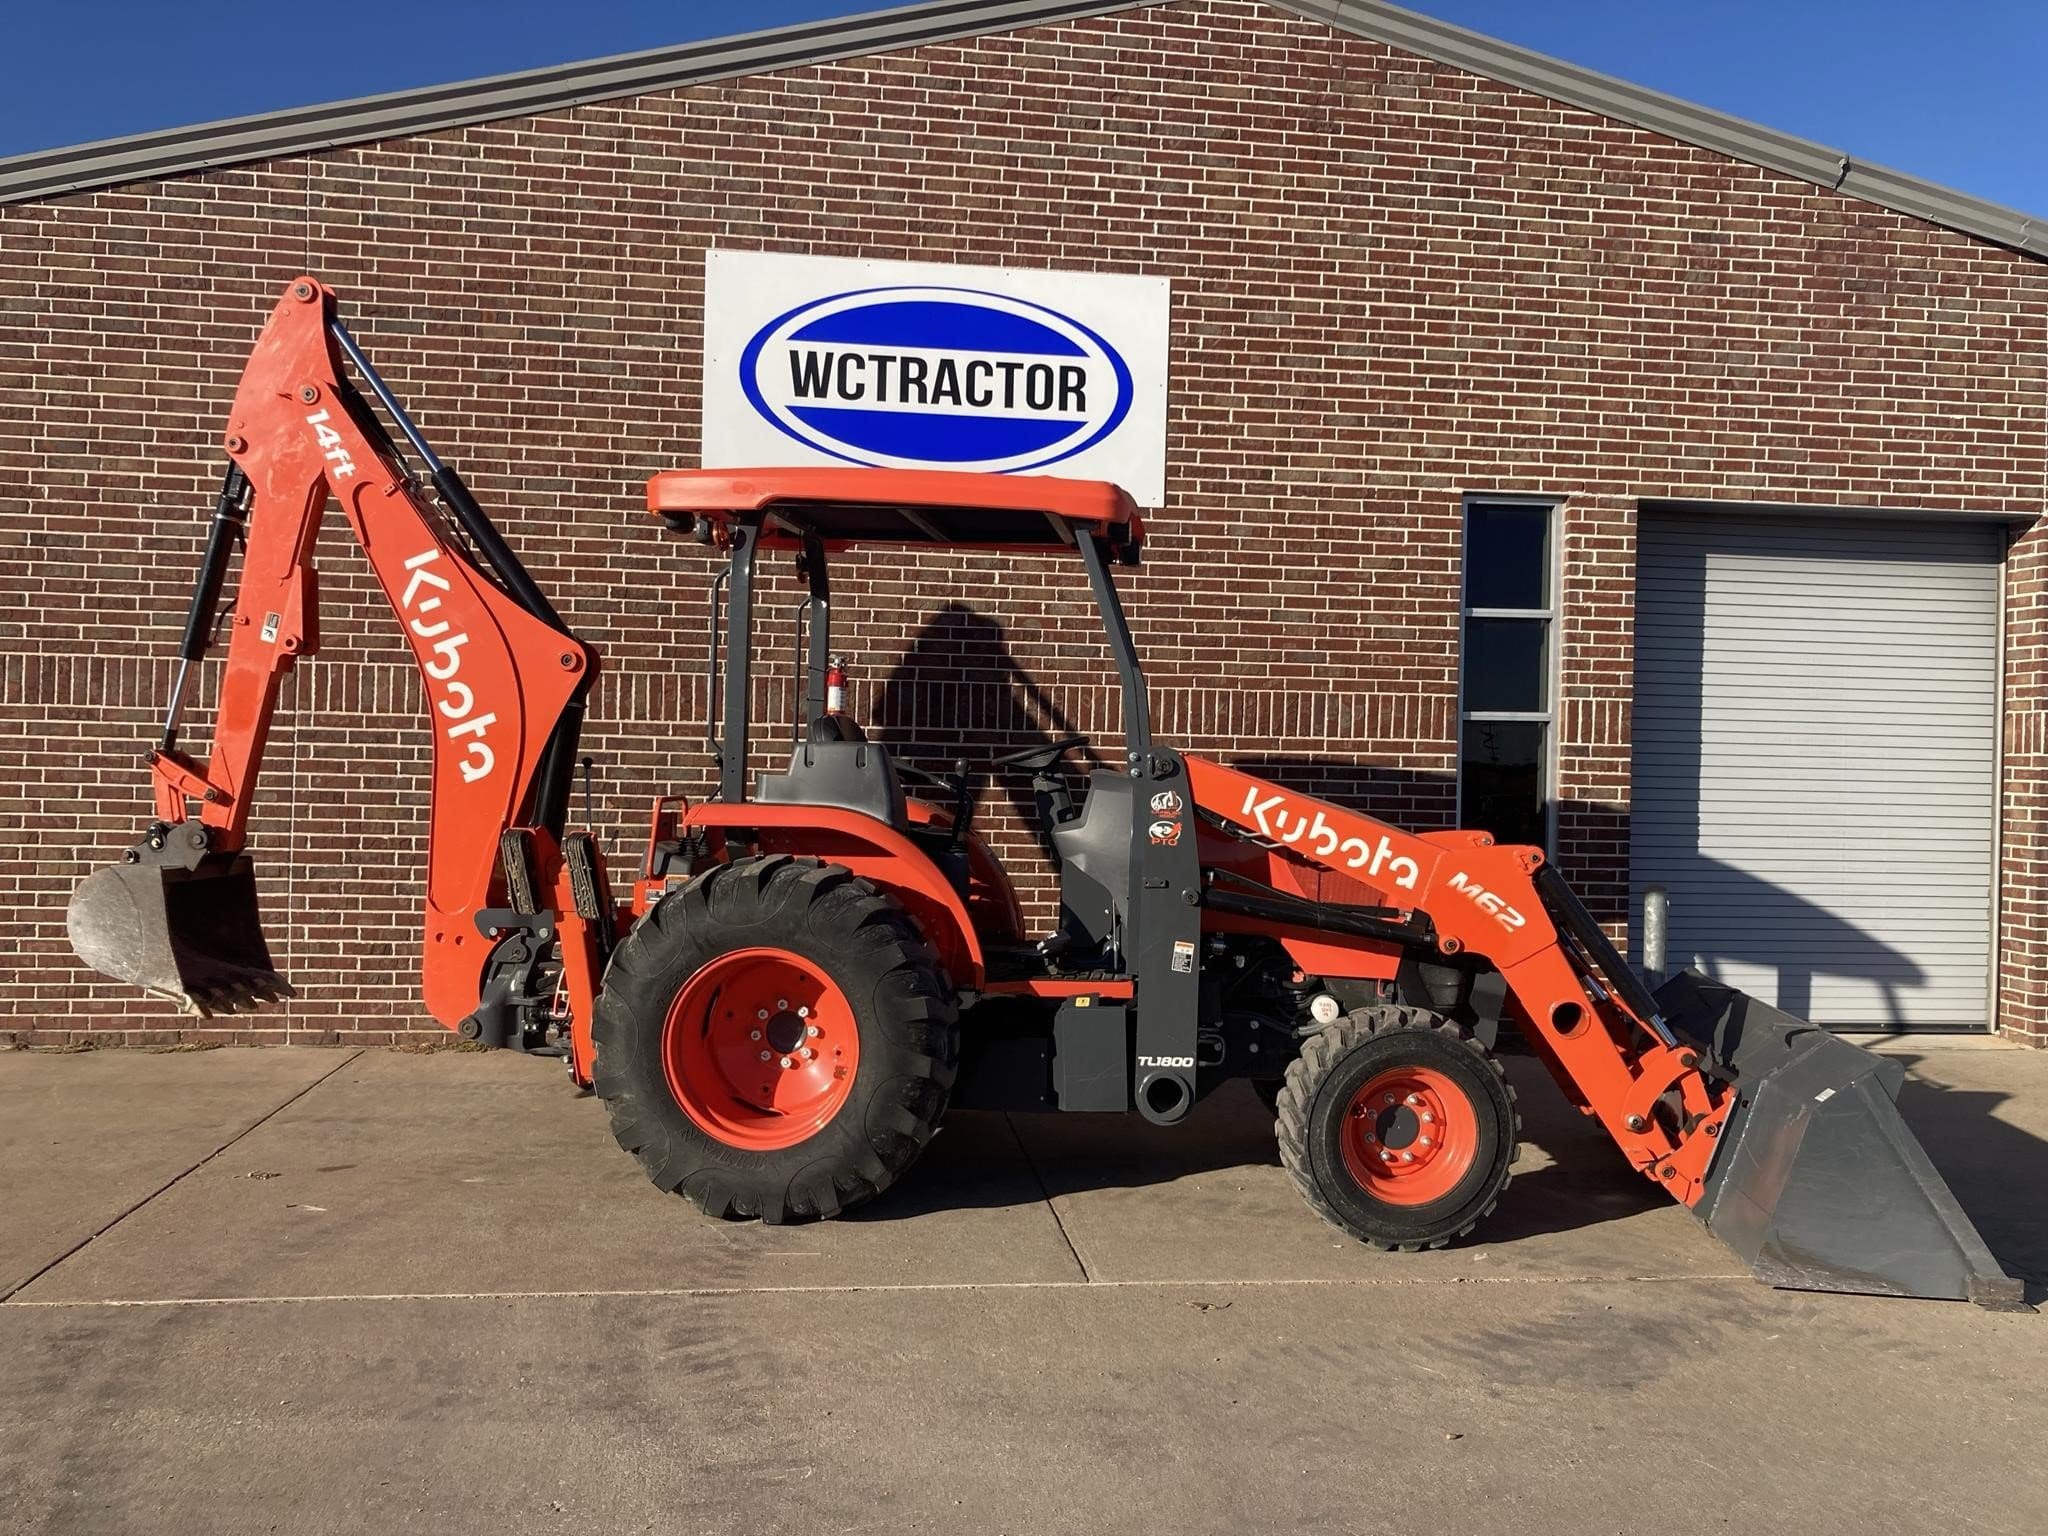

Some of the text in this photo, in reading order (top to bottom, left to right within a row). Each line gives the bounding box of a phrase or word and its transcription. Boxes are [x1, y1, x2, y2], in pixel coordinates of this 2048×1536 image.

[790, 350, 1087, 413] WCTRACTOR
[306, 408, 356, 481] 14ft
[402, 549, 497, 783] Kubota
[1151, 838, 1178, 846] PTO
[1241, 786, 1419, 890] Kubota
[1448, 872, 1527, 932] M62
[1137, 1056, 1194, 1068] TL1800
